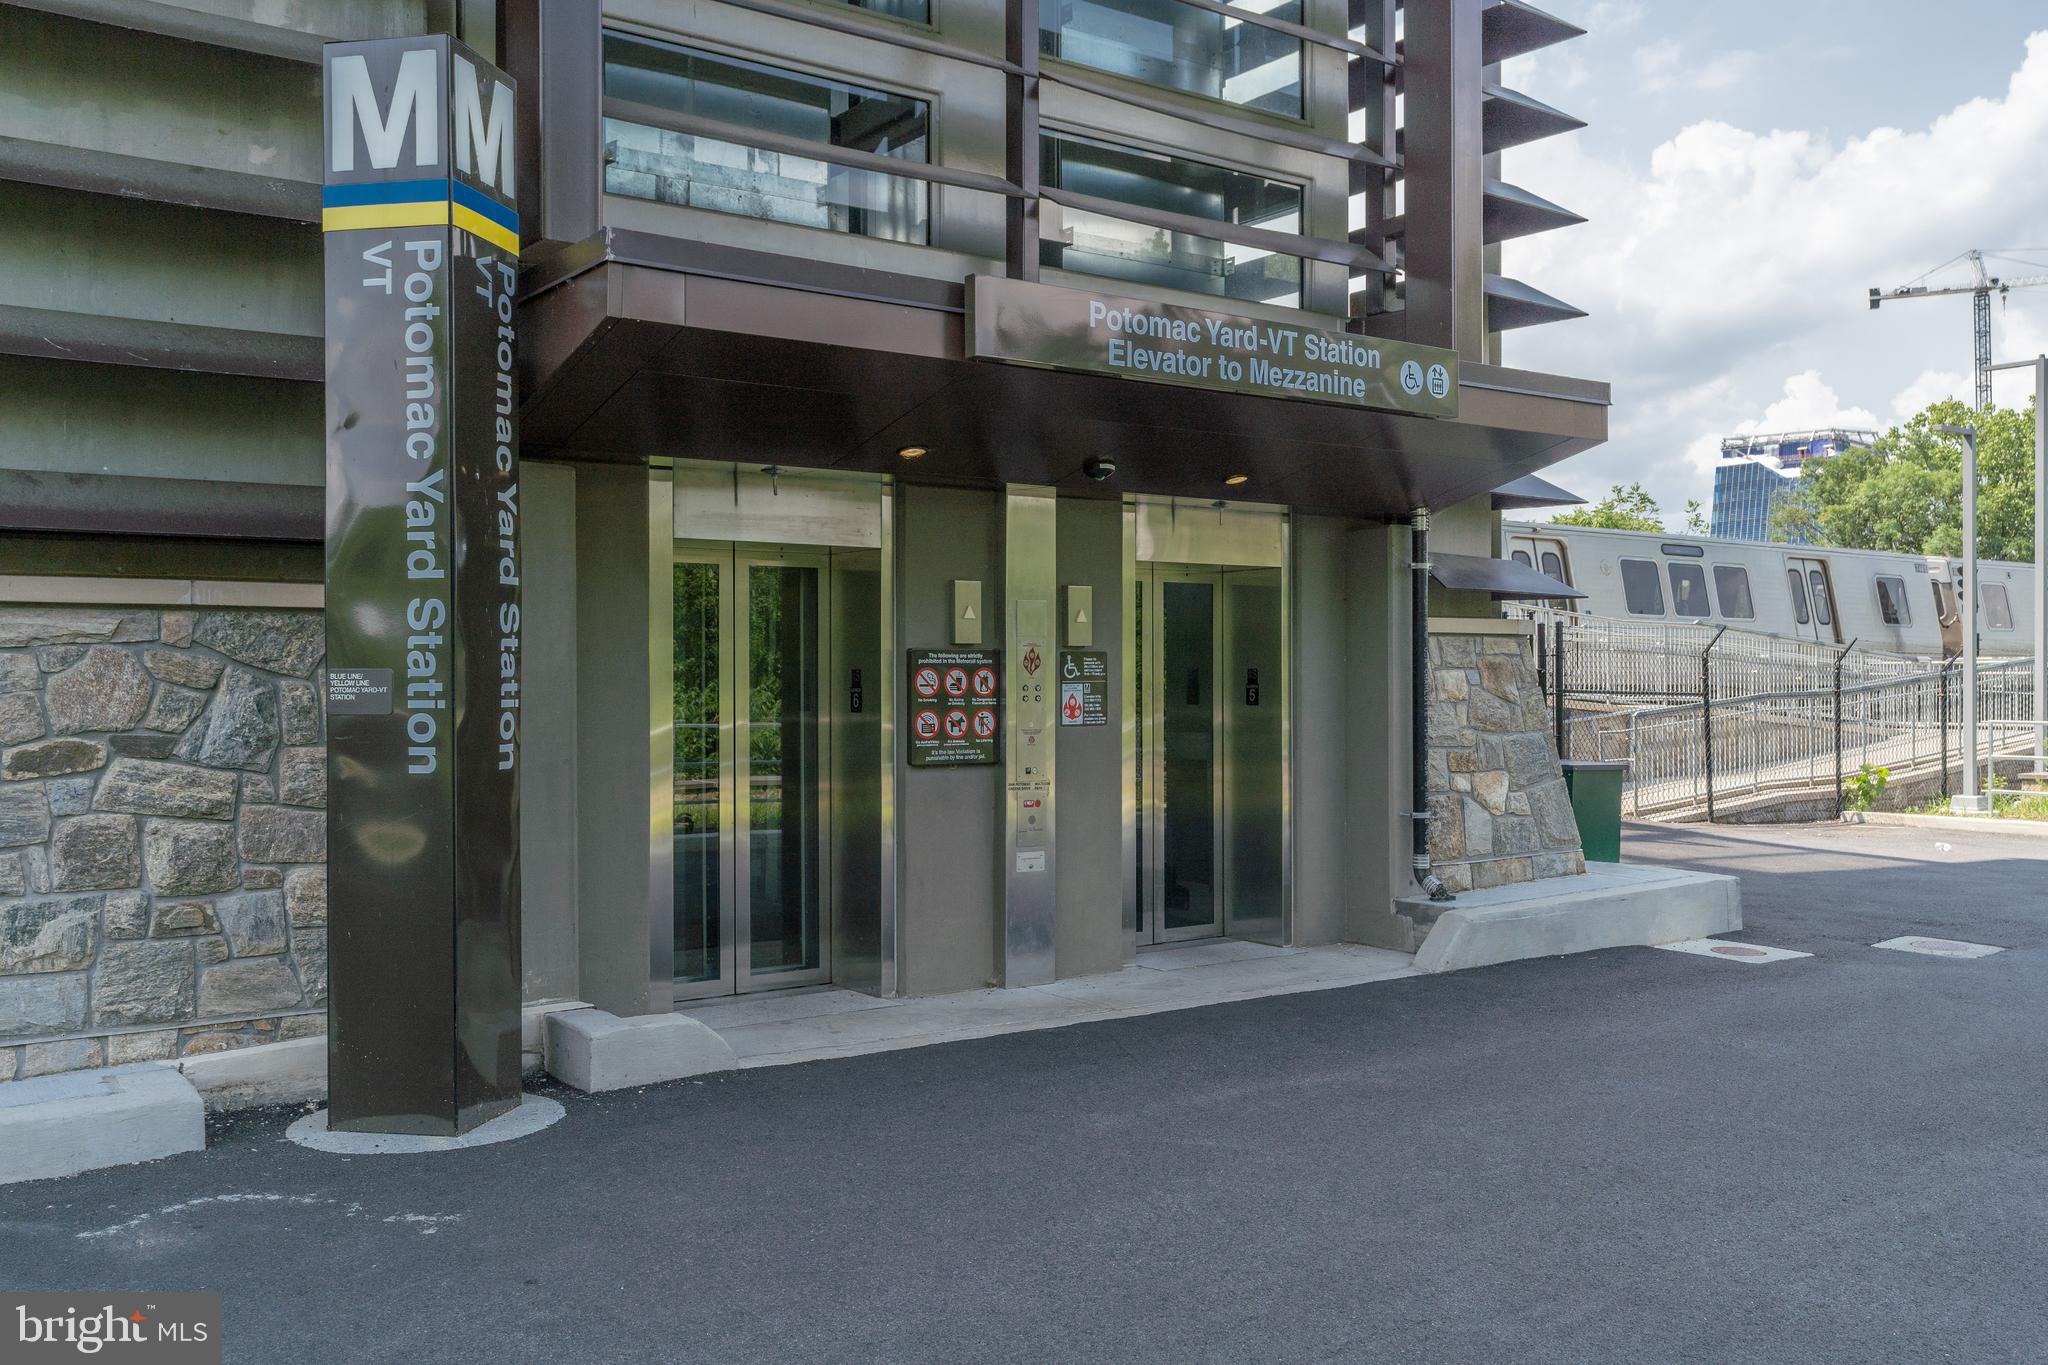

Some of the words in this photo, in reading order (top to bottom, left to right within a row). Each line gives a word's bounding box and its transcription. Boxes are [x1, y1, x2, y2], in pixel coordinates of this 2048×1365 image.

[331, 49, 438, 172] M
[454, 53, 516, 200] M
[363, 240, 393, 295] VT
[475, 256, 493, 308] VT
[404, 240, 442, 460] Potomac
[496, 261, 516, 473] Potomac
[1089, 300, 1201, 343] Potomac
[1205, 318, 1297, 356] Yard-VT
[1304, 333, 1380, 369] Station
[1108, 338, 1212, 377] Elevator
[1219, 354, 1242, 382] to
[1250, 357, 1366, 398] Mezzanine
[406, 468, 445, 579] Yard
[497, 483, 520, 586] Yard
[406, 598, 446, 775] Station
[498, 602, 521, 771] Station
[853, 692, 859, 708] 6
[1249, 688, 1256, 702] 5
